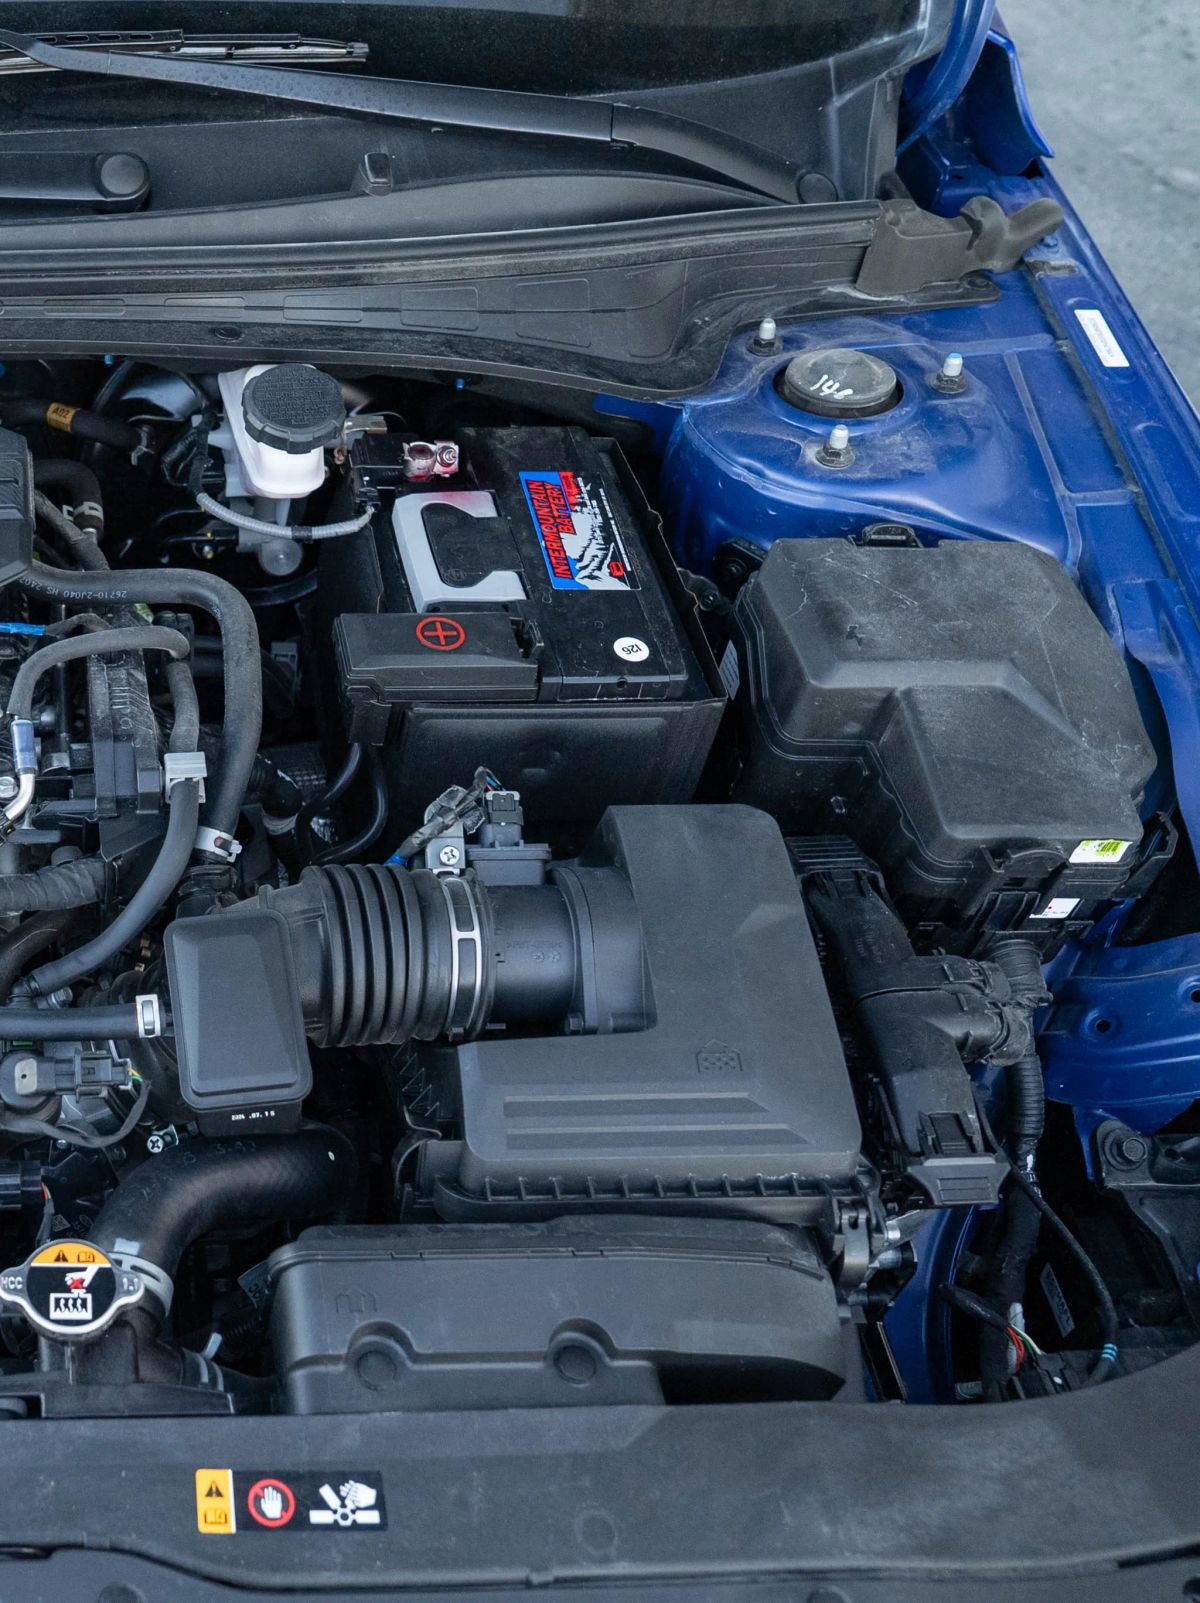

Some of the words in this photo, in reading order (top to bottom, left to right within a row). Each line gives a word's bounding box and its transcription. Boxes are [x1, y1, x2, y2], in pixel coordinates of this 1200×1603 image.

[544, 481, 577, 535] BATTERY
[526, 480, 574, 579] INTERMOUNTAIN
[621, 643, 642, 655] 126
[0, 1276, 23, 1289] HCC
[122, 1277, 139, 1291] 1.1
